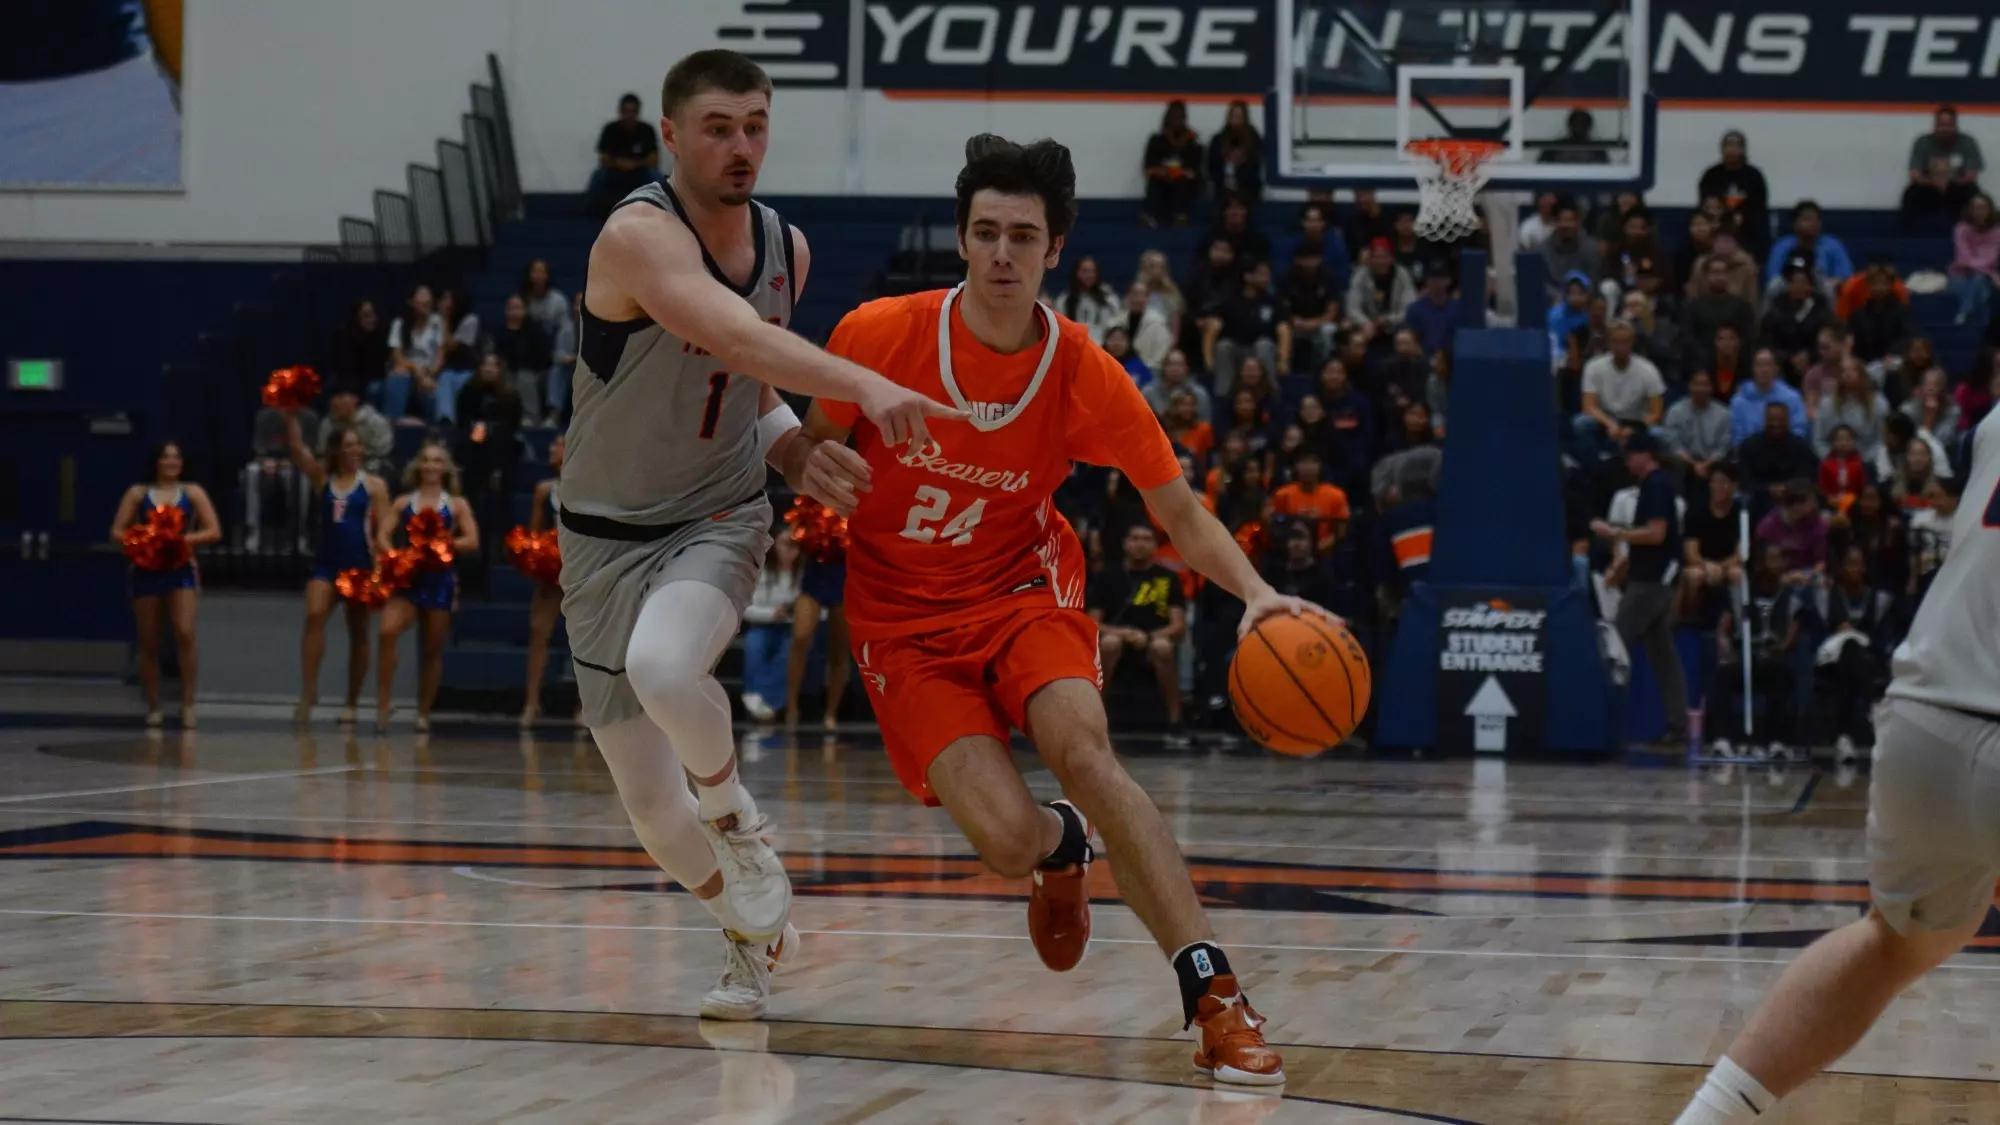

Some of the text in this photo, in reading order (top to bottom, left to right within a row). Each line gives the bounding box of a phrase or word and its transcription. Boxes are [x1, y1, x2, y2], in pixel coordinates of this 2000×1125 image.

[867, 5, 1258, 68] YOU'RE
[1292, 9, 1404, 70] IN
[699, 371, 729, 438] 1
[896, 438, 1032, 492] Beavers
[898, 484, 989, 547] 24
[1440, 652, 1544, 672] ENTRANCE
[1447, 632, 1537, 653] STUDENT
